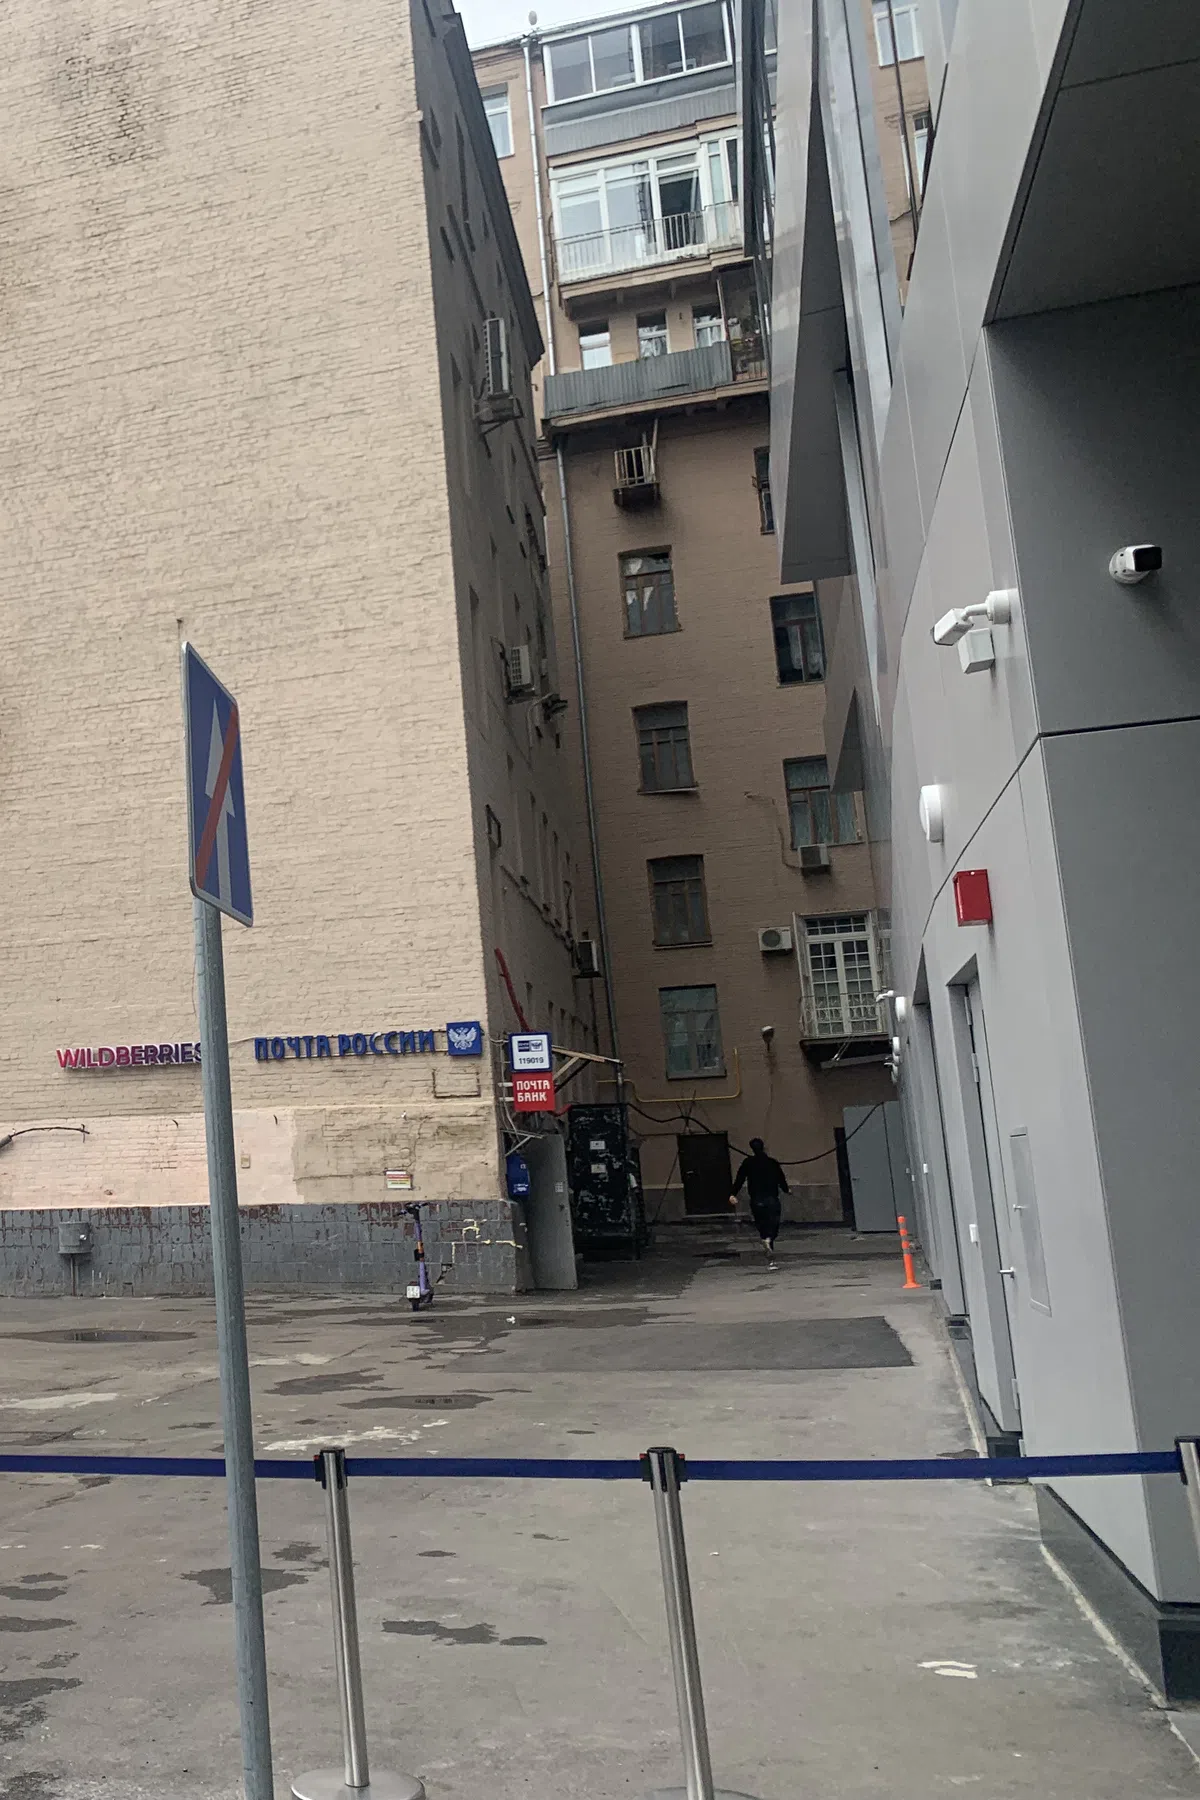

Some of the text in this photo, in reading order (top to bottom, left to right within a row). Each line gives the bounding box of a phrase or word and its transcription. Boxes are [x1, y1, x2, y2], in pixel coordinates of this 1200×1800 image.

[255, 1030, 435, 1060] ПОЧТА РОССИИ
[518, 1057, 544, 1065] 119019
[516, 1080, 550, 1091] ПОЧТА
[517, 1092, 547, 1102] БАНК
